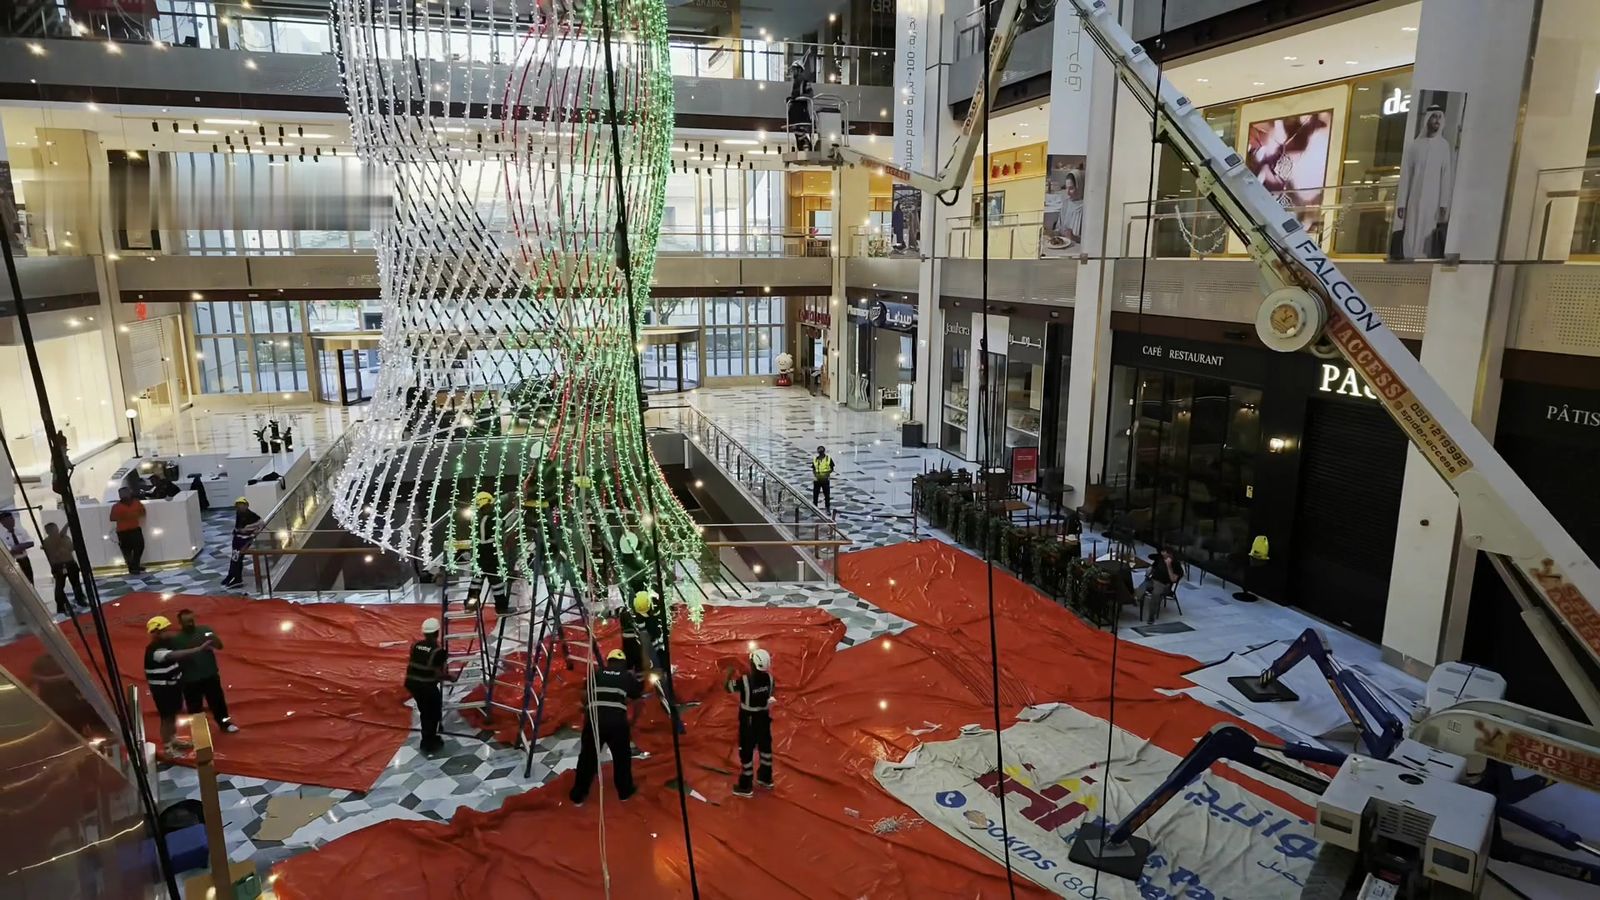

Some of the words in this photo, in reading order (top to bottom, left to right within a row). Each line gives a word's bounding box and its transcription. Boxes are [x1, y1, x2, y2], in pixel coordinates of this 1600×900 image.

[1296, 239, 1382, 332] FALCON
[1142, 345, 1162, 357] CAFÉ
[1169, 349, 1224, 366] RESTAURANT
[1338, 329, 1402, 400] ACCESS
